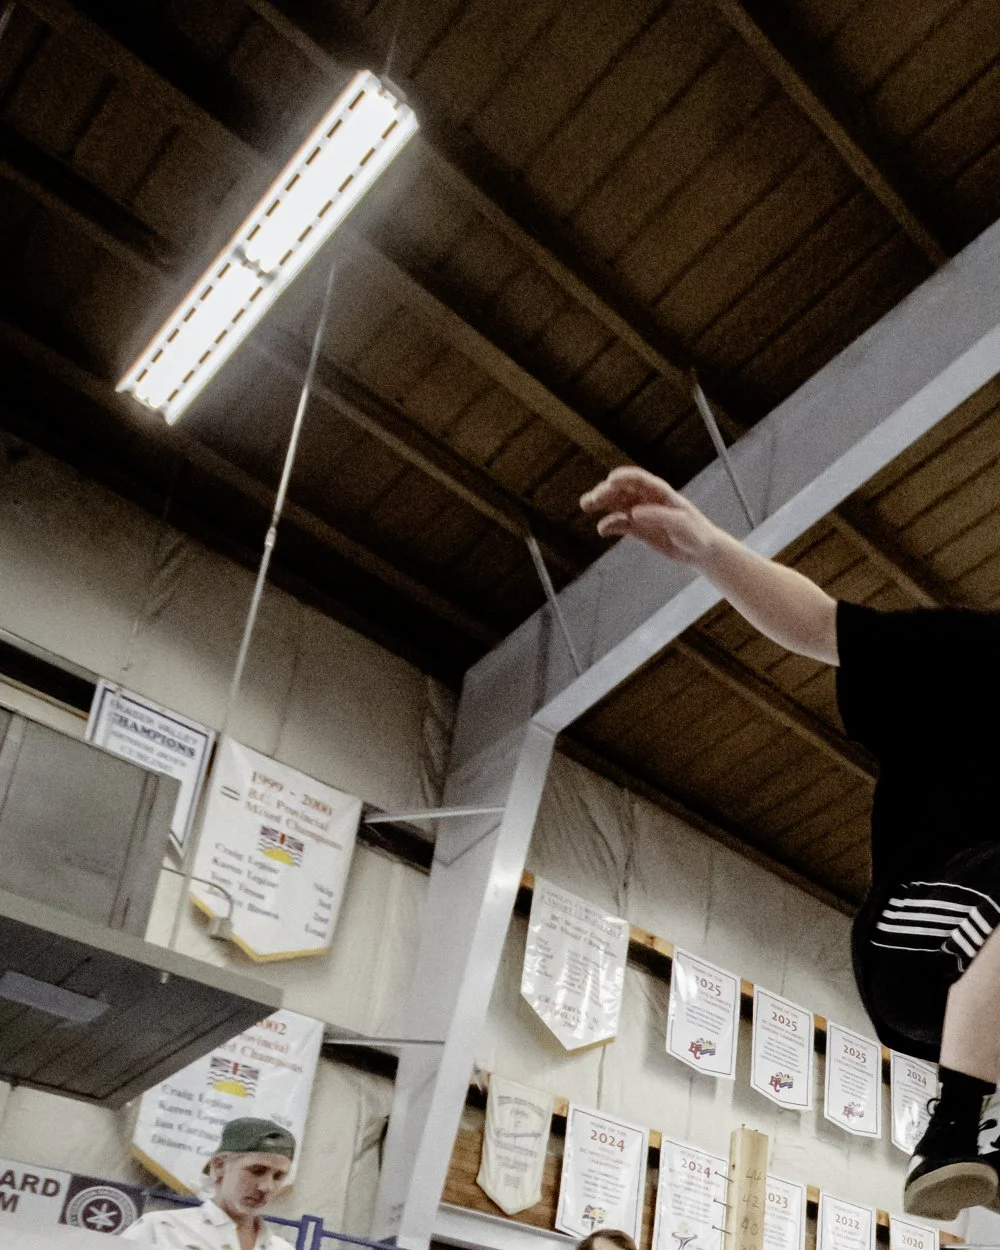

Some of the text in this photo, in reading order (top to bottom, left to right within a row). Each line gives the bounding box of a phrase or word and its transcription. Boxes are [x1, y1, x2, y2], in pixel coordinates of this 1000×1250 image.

[771, 1010, 798, 1032] 2025
[843, 1044, 867, 1064] 2025
[906, 1069, 927, 1088] 2024
[590, 1129, 626, 1153] 2024
[680, 1158, 711, 1179] 2024
[0, 1169, 61, 1198] ARD
[742, 1193, 760, 1209] 42
[767, 1192, 789, 1209] 023
[834, 1213, 860, 1230] 2022
[901, 1234, 924, 1250] 2020
